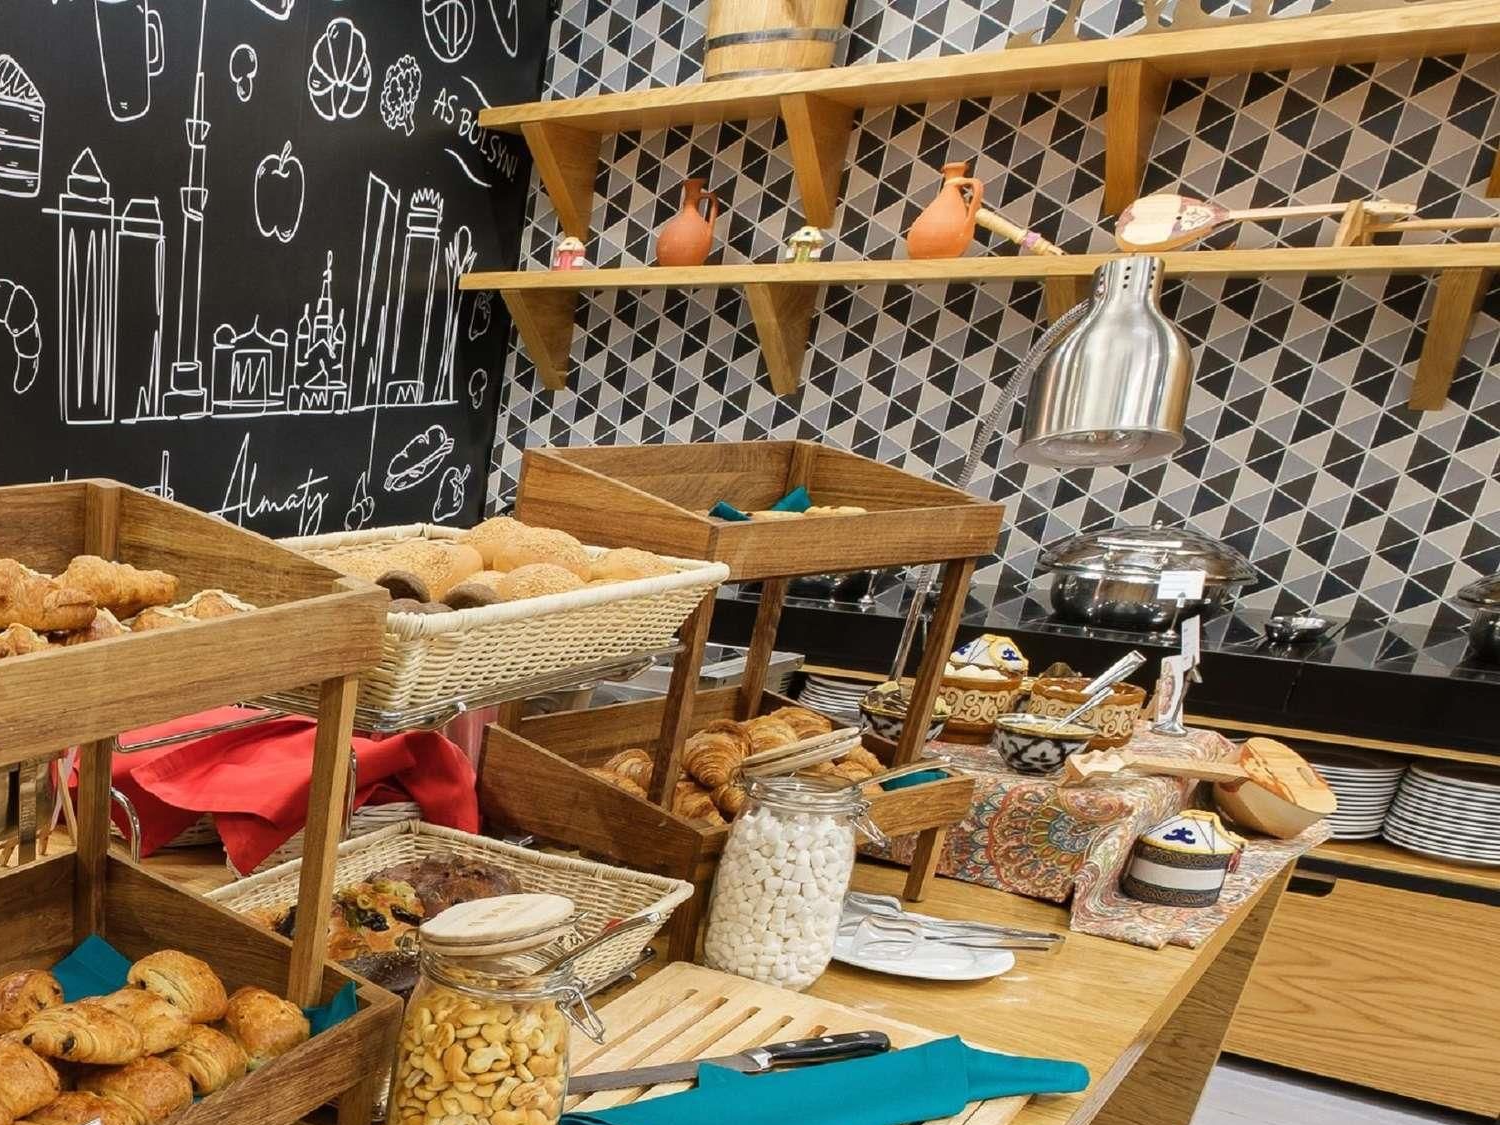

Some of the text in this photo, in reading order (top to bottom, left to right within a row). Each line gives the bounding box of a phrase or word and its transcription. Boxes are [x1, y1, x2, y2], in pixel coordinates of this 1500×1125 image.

[432, 88, 518, 182] AS BOLSYN!
[209, 433, 330, 535] Almaty
